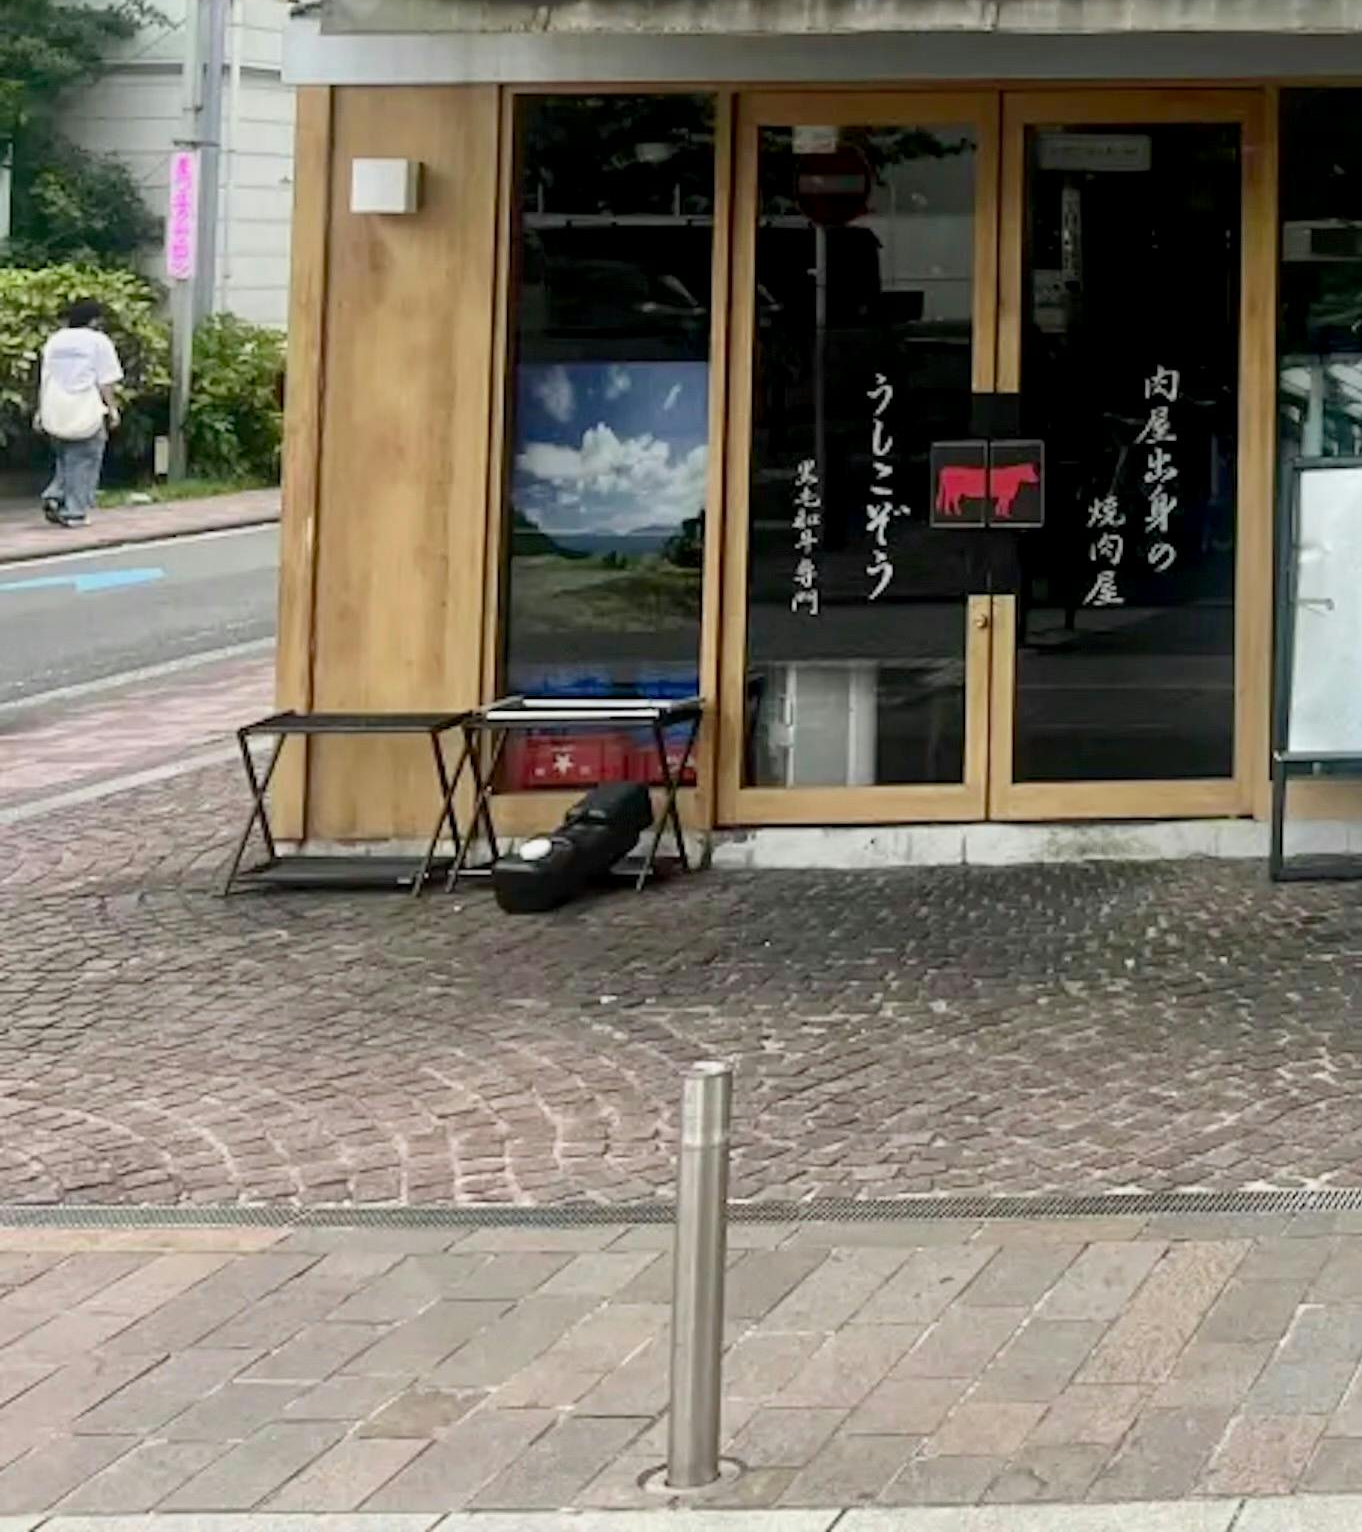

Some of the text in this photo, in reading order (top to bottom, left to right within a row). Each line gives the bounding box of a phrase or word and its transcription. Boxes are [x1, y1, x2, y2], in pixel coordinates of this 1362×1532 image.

[866, 372, 911, 600] うしこぞう
[1082, 494, 1127, 606] 焼肉屋
[1134, 364, 1180, 572] 肉屋出身の
